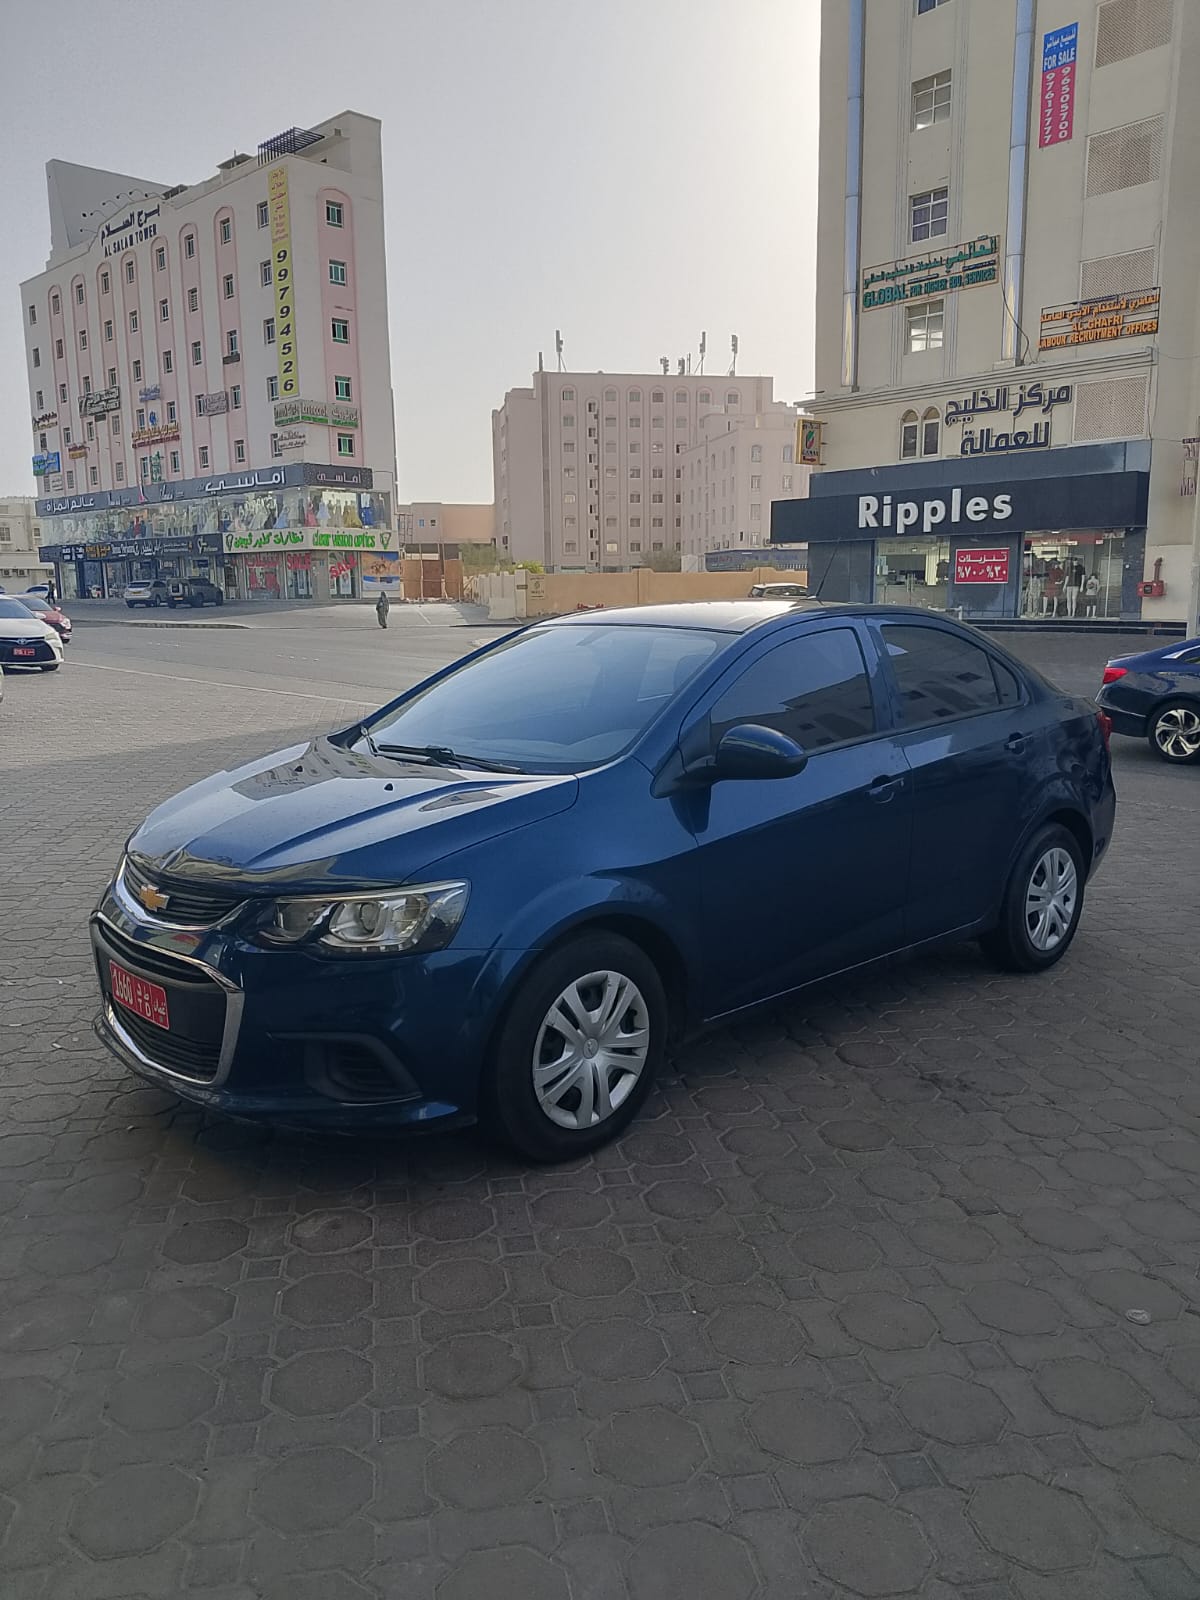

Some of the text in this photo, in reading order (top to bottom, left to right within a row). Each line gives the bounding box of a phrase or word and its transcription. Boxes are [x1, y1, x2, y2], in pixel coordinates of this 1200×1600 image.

[1043, 47, 1075, 71] FOR SALE
[1043, 72, 1056, 144] 97617777
[1058, 66, 1072, 139] 96505700
[105, 224, 157, 258] AL SALAM TOWER
[863, 283, 908, 308] GLOBAL
[909, 284, 922, 297] FOR
[924, 279, 947, 294] HIGHER
[965, 267, 996, 285] SERVICES
[276, 249, 294, 391] 99794526
[1070, 326, 1123, 344] RECRUITMENT
[1125, 320, 1158, 335] OFFICES
[945, 383, 1071, 426] مركز الخليج
[961, 421, 1050, 455] للعمالة
[858, 488, 1013, 534] Ripples
[332, 530, 353, 547] vision
[354, 531, 376, 548] optics
[287, 552, 311, 570] SALE
[329, 554, 357, 579] SALE
[958, 551, 1007, 564] تنزيلات
